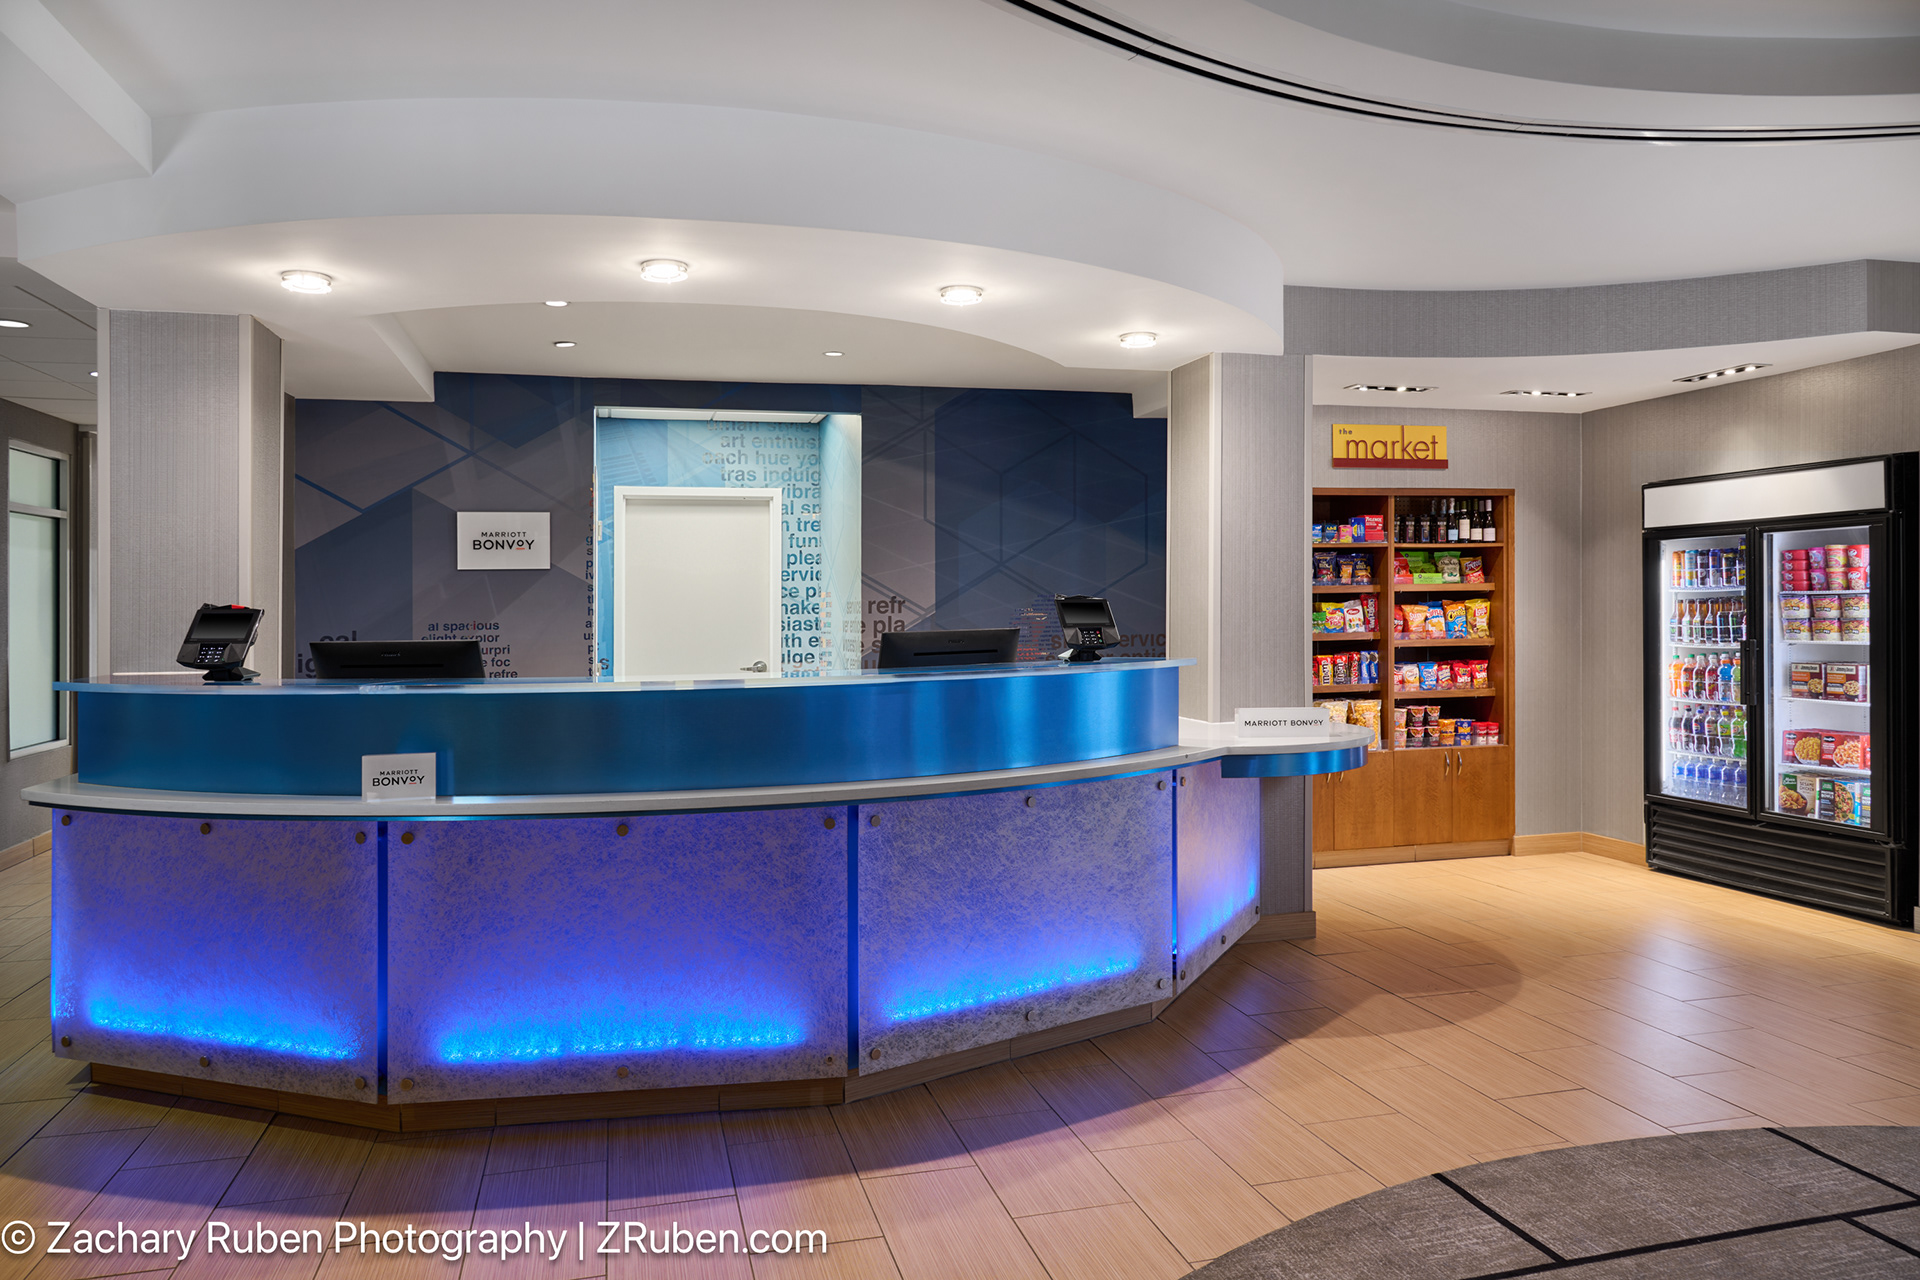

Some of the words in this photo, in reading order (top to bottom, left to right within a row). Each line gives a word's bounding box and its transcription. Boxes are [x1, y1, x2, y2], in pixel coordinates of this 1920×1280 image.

[720, 434, 746, 448] art
[1346, 425, 1438, 460] market
[755, 451, 790, 465] hue
[473, 539, 535, 550] BONVOY
[868, 596, 905, 614] refr
[428, 622, 438, 631] al
[443, 621, 500, 633] spacious
[874, 616, 905, 638] pla
[492, 657, 511, 667] foc
[1244, 719, 1287, 727] MARRIOTT
[1290, 719, 1324, 727] BONVOY
[372, 775, 425, 787] BONVOY
